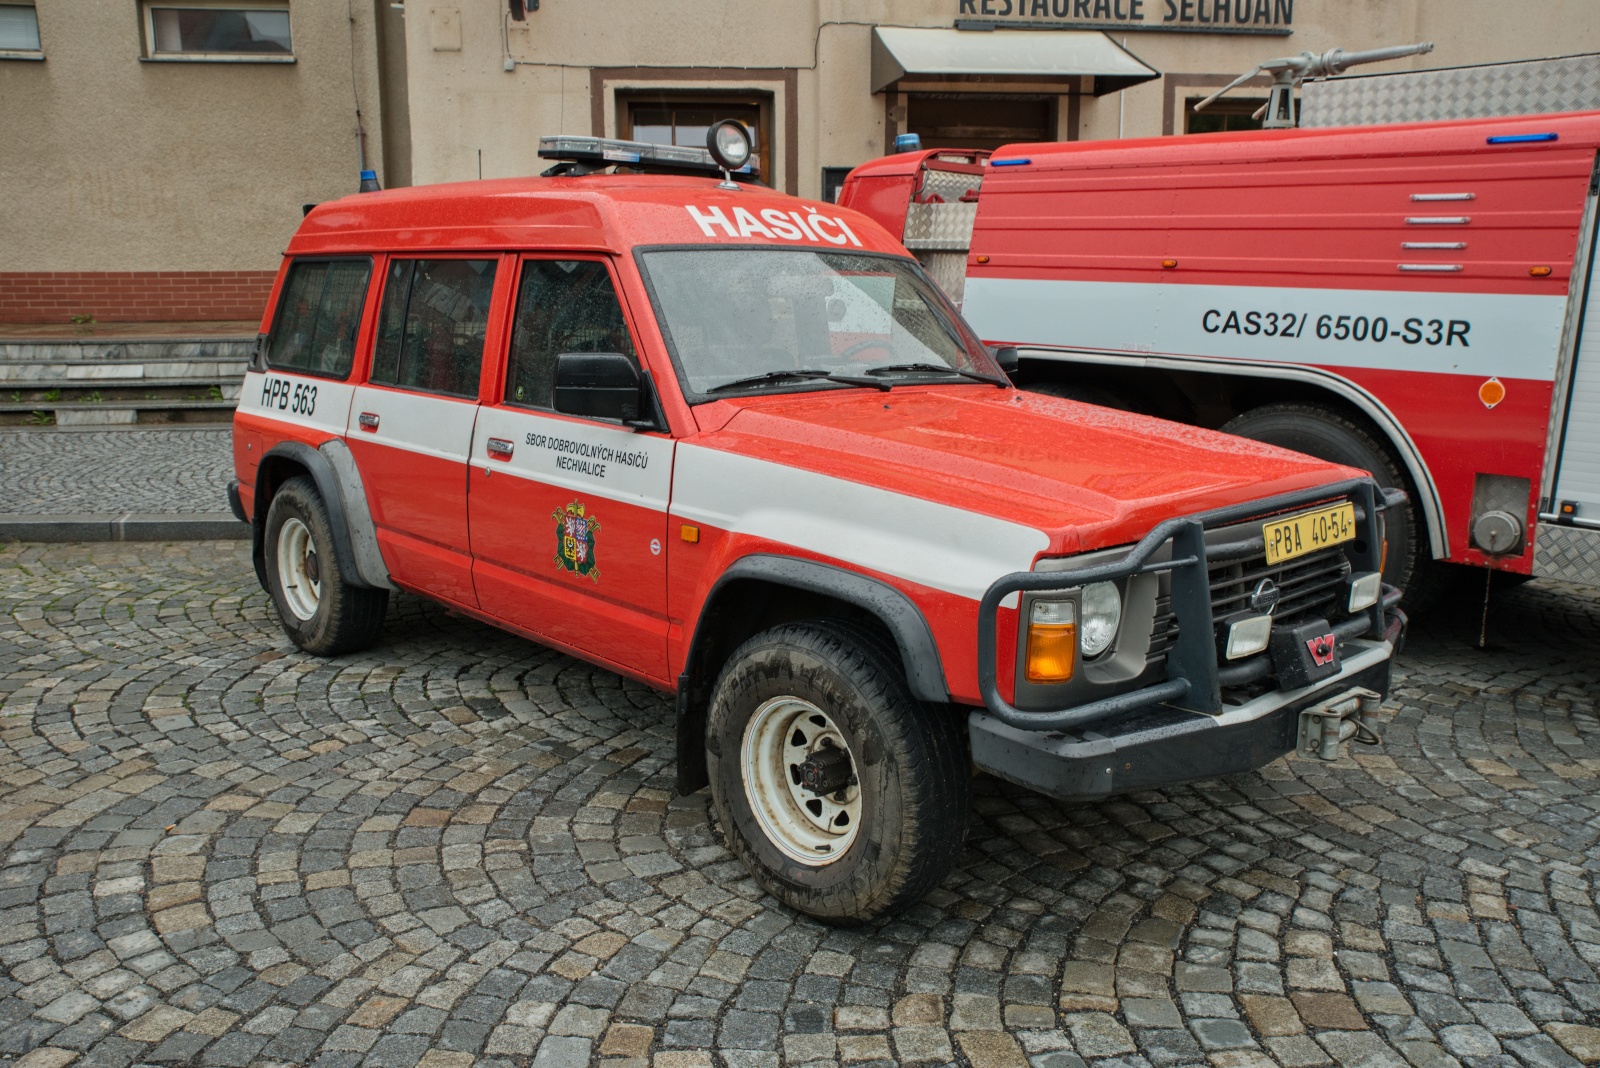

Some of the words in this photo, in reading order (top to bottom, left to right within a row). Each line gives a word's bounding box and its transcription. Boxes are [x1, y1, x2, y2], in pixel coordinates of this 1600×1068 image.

[1163, 0, 1294, 25] SECHUAN
[684, 205, 863, 247] HASIČI
[1202, 309, 1308, 338] CAS32/
[1315, 314, 1472, 347] 6500-S3R
[261, 377, 291, 410] HPB
[292, 383, 318, 417] 563
[525, 432, 547, 448] SBOR
[547, 437, 614, 462] DOBROVOLNÝCH
[615, 450, 649, 469] HASIČŮ
[556, 455, 606, 478] NECHVALICE
[1274, 522, 1302, 557] PBA
[1312, 510, 1348, 545] 40-54
